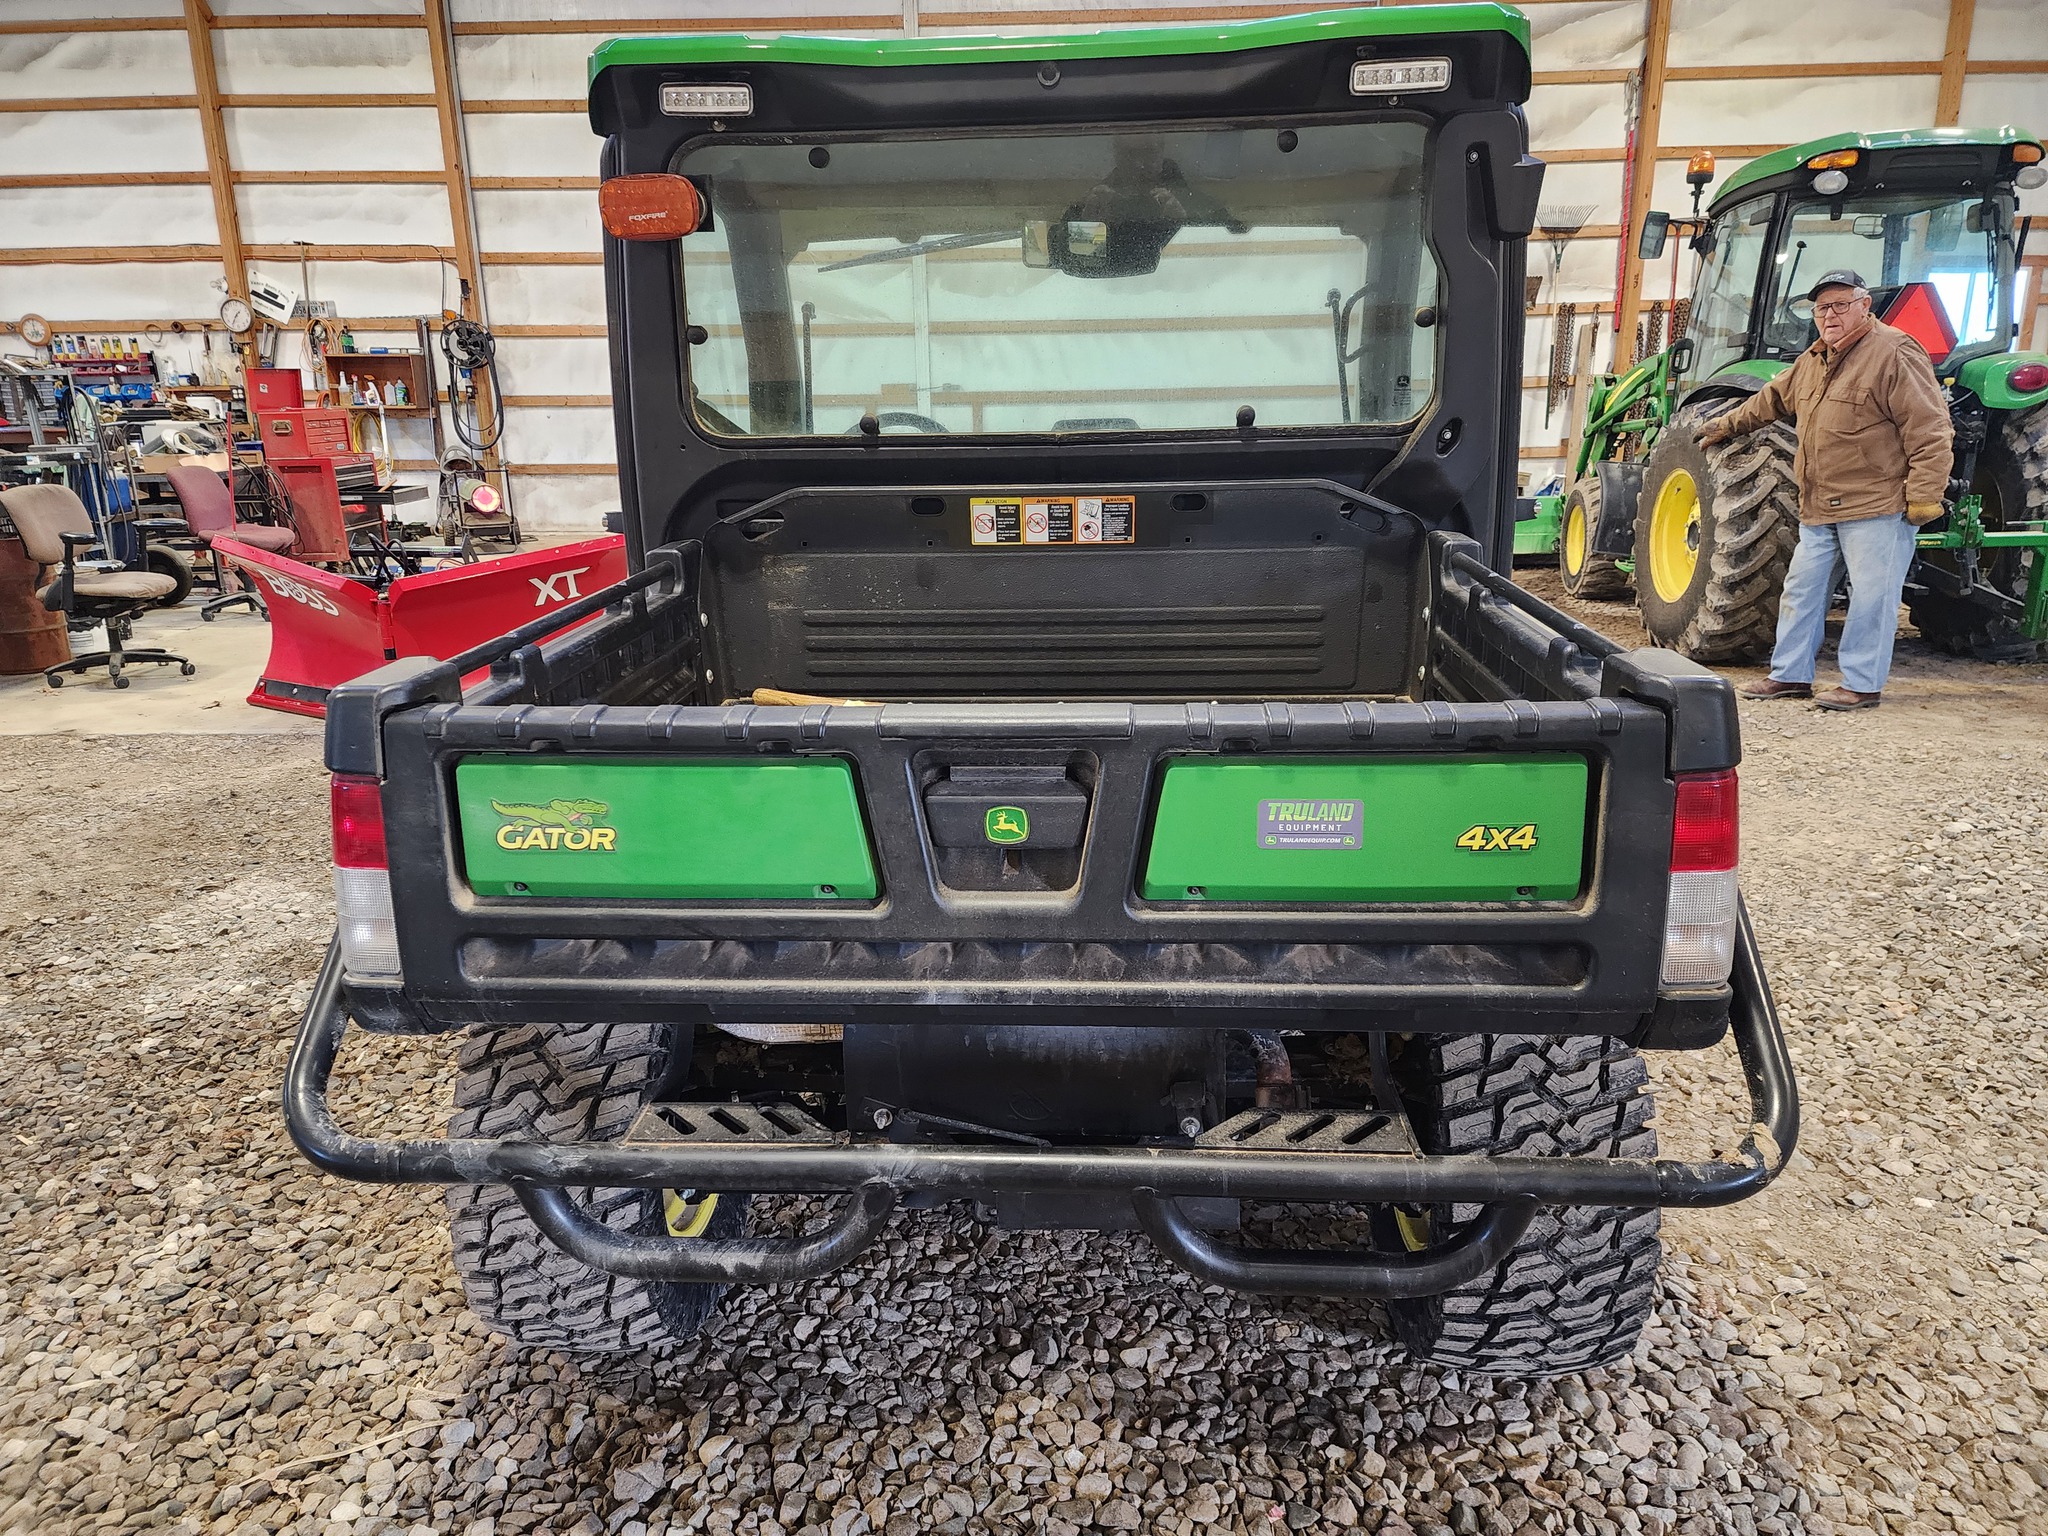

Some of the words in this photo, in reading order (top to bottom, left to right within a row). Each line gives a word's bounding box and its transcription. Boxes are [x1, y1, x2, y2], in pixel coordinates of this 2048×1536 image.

[628, 212, 668, 222] FOXFIRE
[260, 570, 340, 617] BOSS
[527, 566, 591, 607] XT
[1267, 802, 1355, 822] TRULAND
[496, 825, 616, 850] GATOR
[1278, 823, 1343, 832] EQUIPMENT
